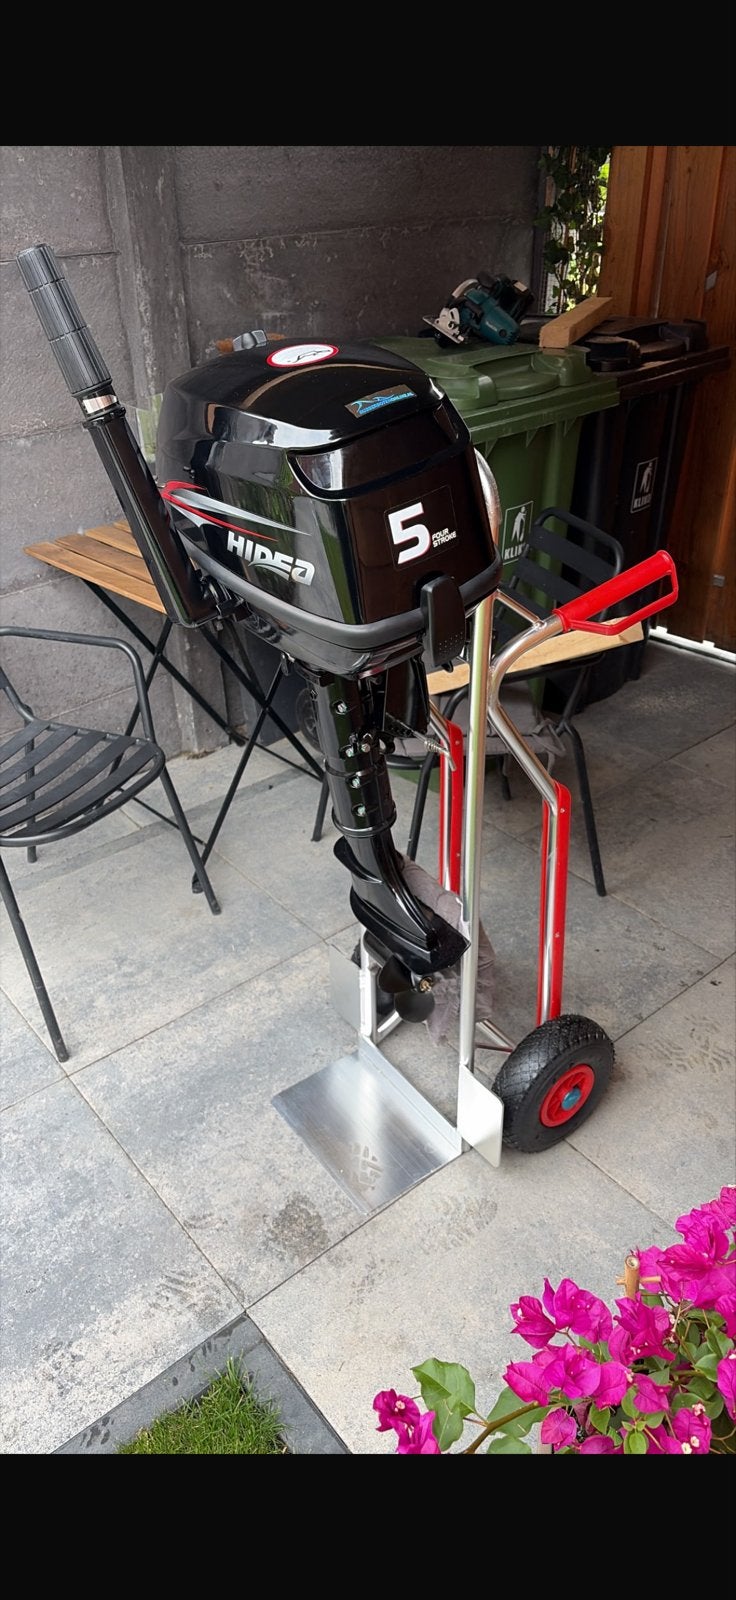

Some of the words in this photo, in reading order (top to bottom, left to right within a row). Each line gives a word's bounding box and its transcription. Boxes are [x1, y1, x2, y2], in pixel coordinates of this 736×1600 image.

[388, 502, 431, 564] 5
[431, 527, 449, 541] FOUR
[432, 530, 457, 548] STROKE
[227, 530, 315, 586] HIDEA
[504, 543, 526, 560] KLIK
